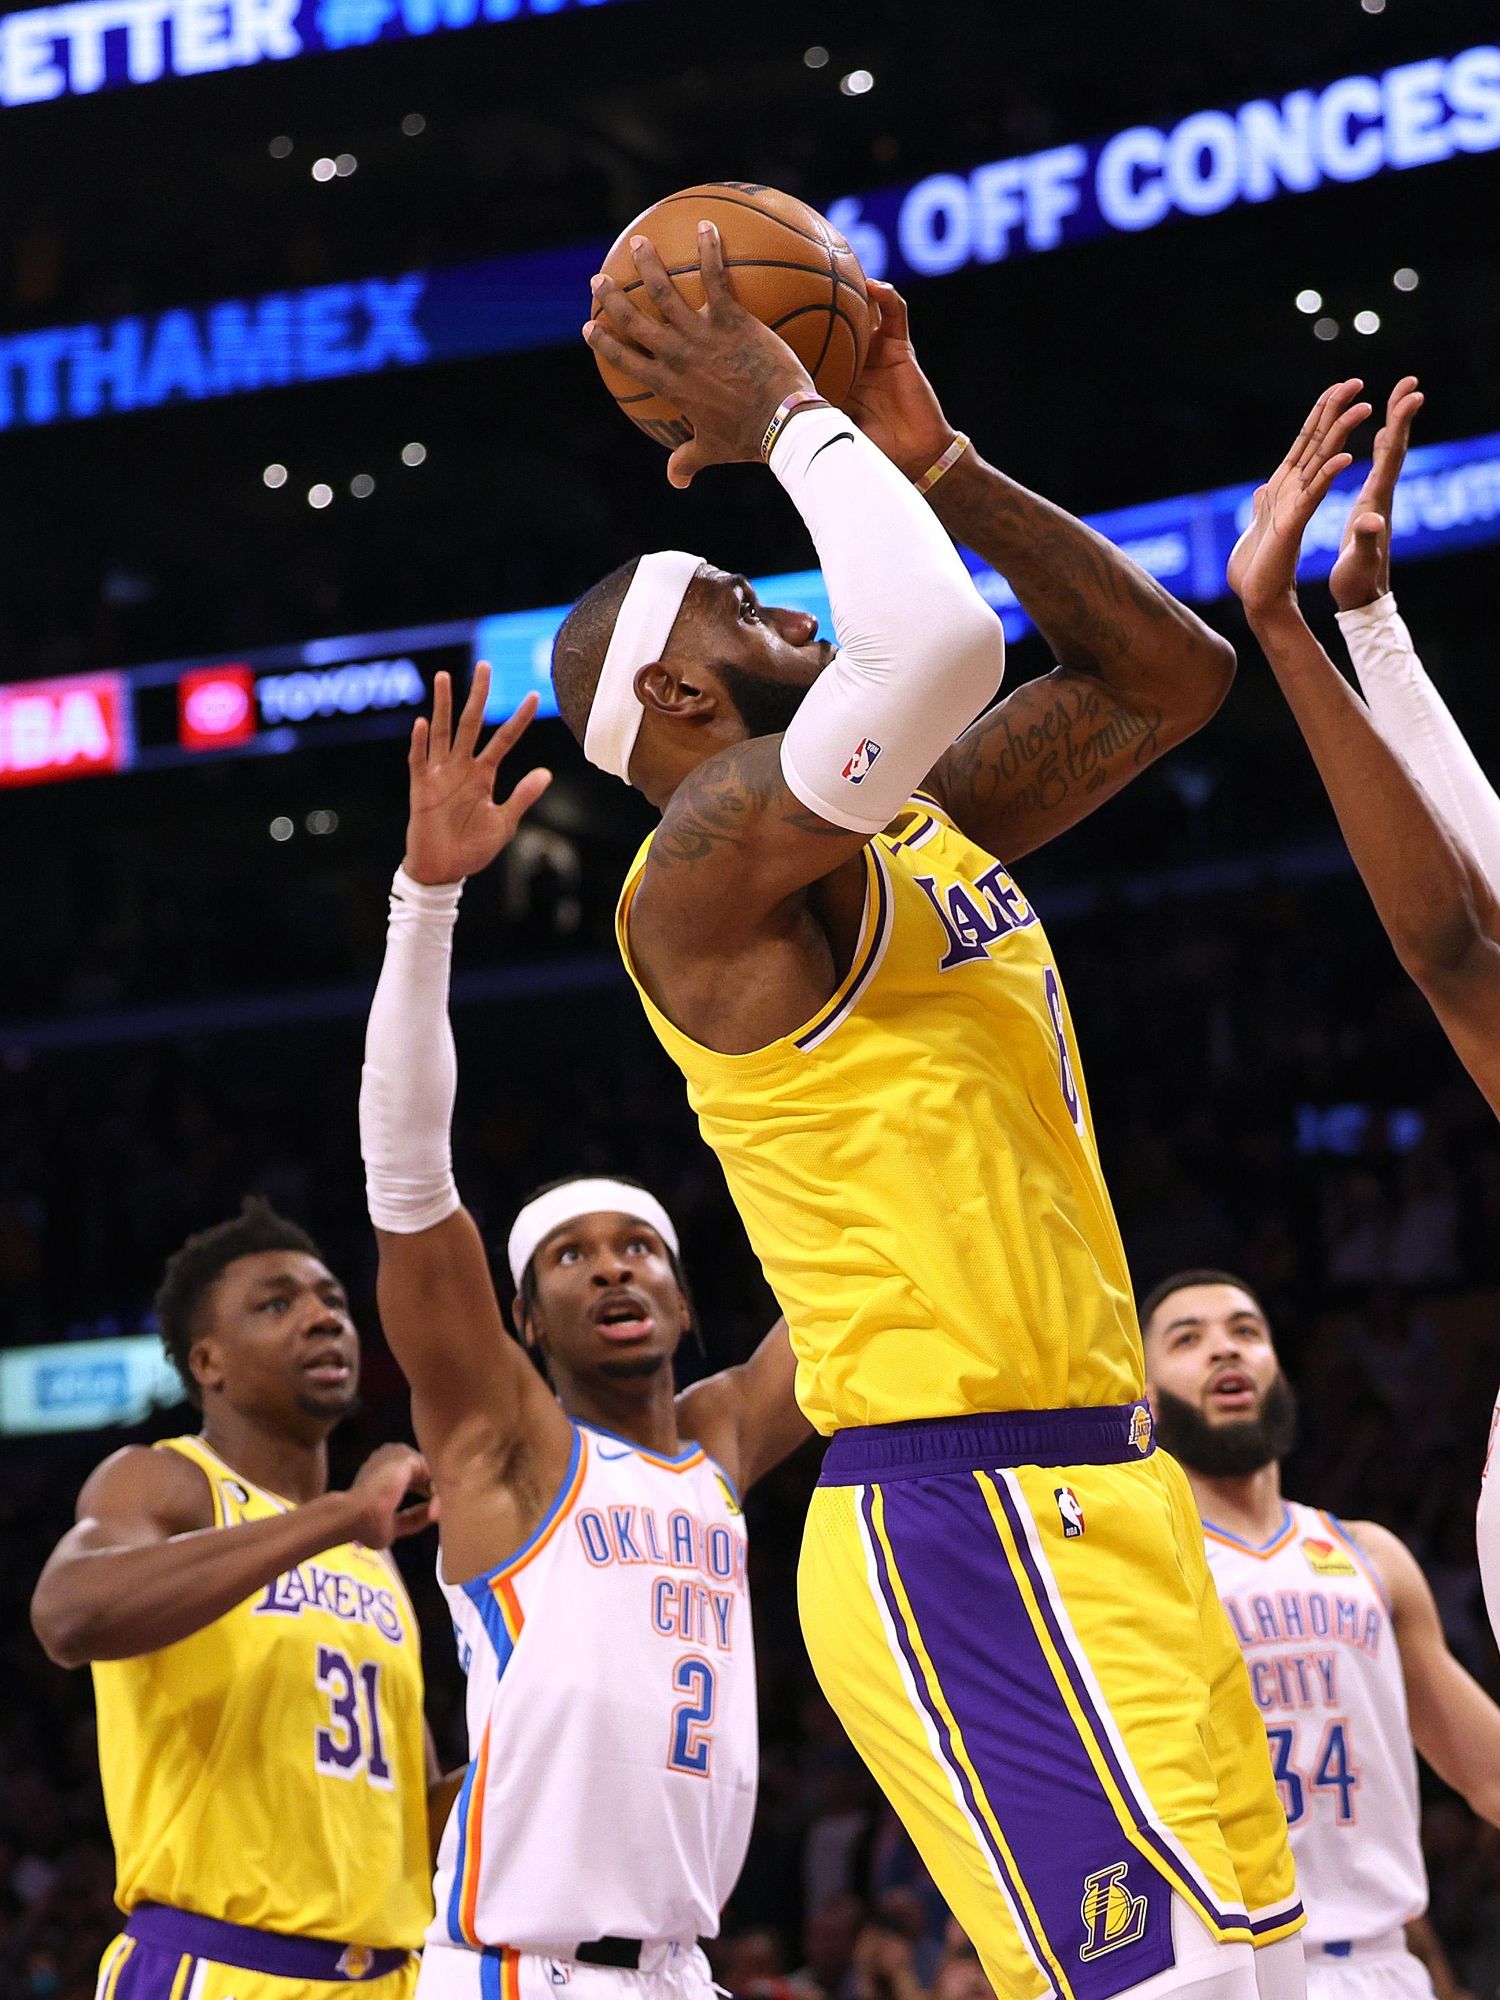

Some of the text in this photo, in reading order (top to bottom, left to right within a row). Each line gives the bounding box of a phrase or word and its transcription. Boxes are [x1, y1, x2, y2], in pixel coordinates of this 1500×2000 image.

[897, 143, 1090, 278] OFF
[1096, 45, 1500, 231] CONCES
[0, 690, 112, 773] BA
[250, 1562, 404, 1649] LAKERS
[1221, 1588, 1382, 1660] LAHOMA
[314, 1642, 396, 1792] 31
[666, 1654, 717, 1779] 2
[1248, 1652, 1339, 1712] CITY
[1263, 1716, 1361, 1833] 34
